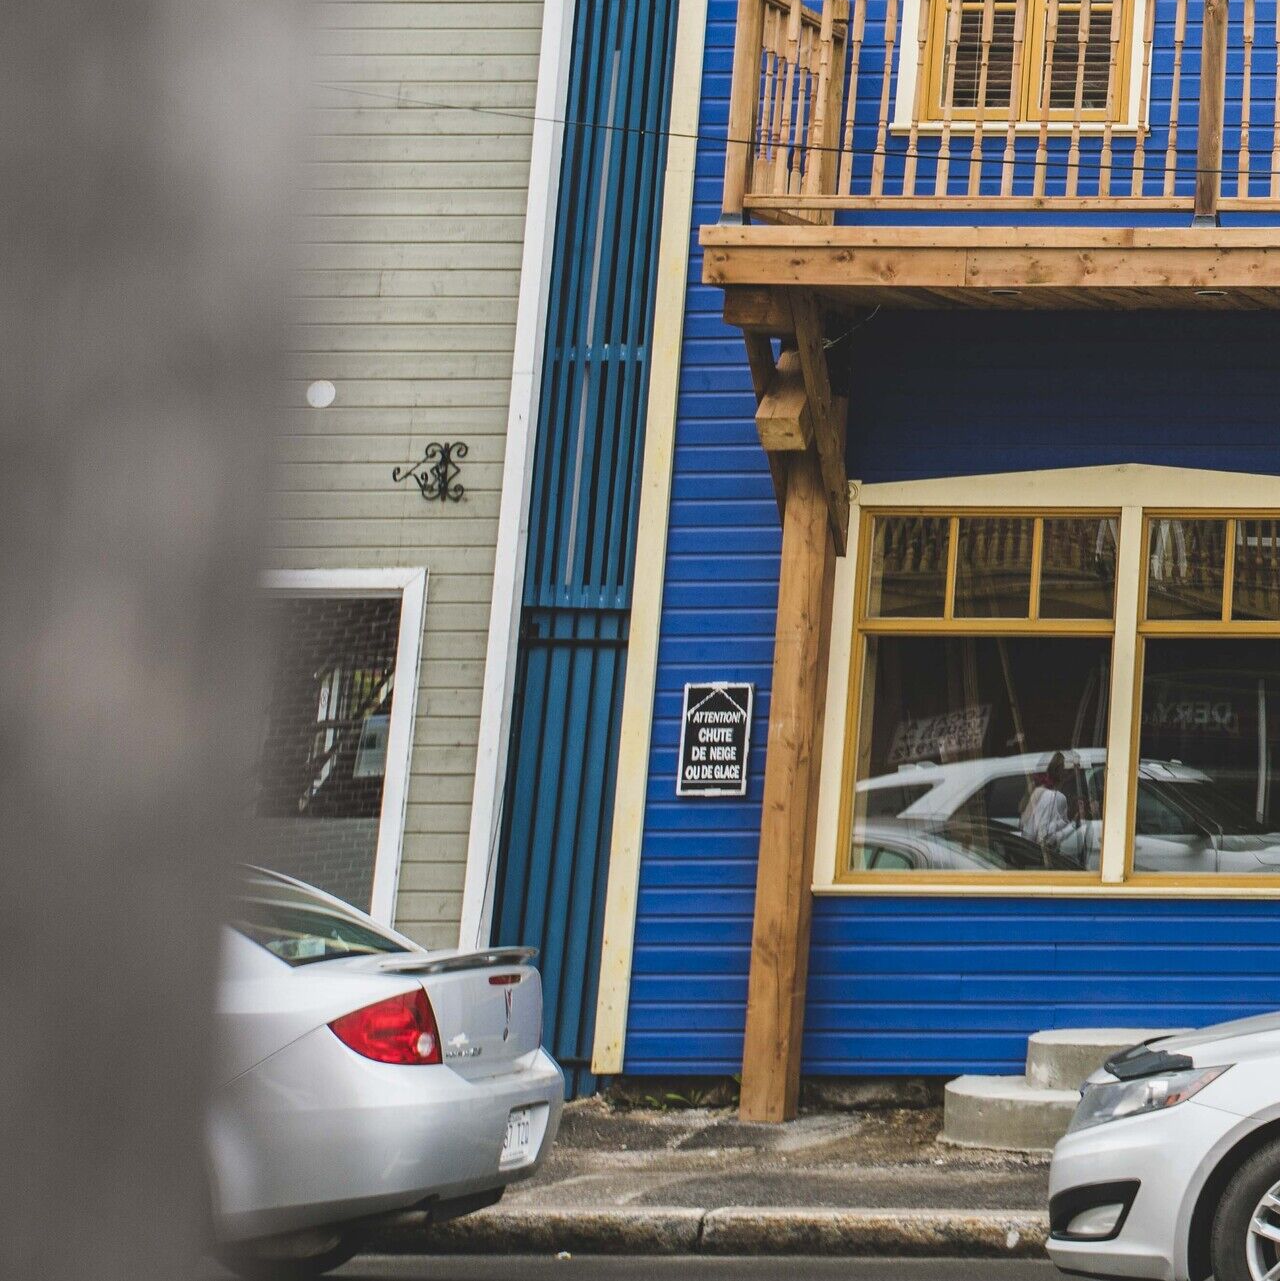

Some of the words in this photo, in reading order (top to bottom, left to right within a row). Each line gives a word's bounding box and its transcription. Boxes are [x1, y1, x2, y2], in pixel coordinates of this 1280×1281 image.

[693, 711, 740, 723] ATTENTION!
[698, 727, 733, 742] CHUTE
[691, 746, 706, 761] DE
[709, 746, 736, 761] NEIGE
[685, 765, 700, 780] OU
[701, 765, 713, 779] DE
[714, 765, 740, 779] GLACE
